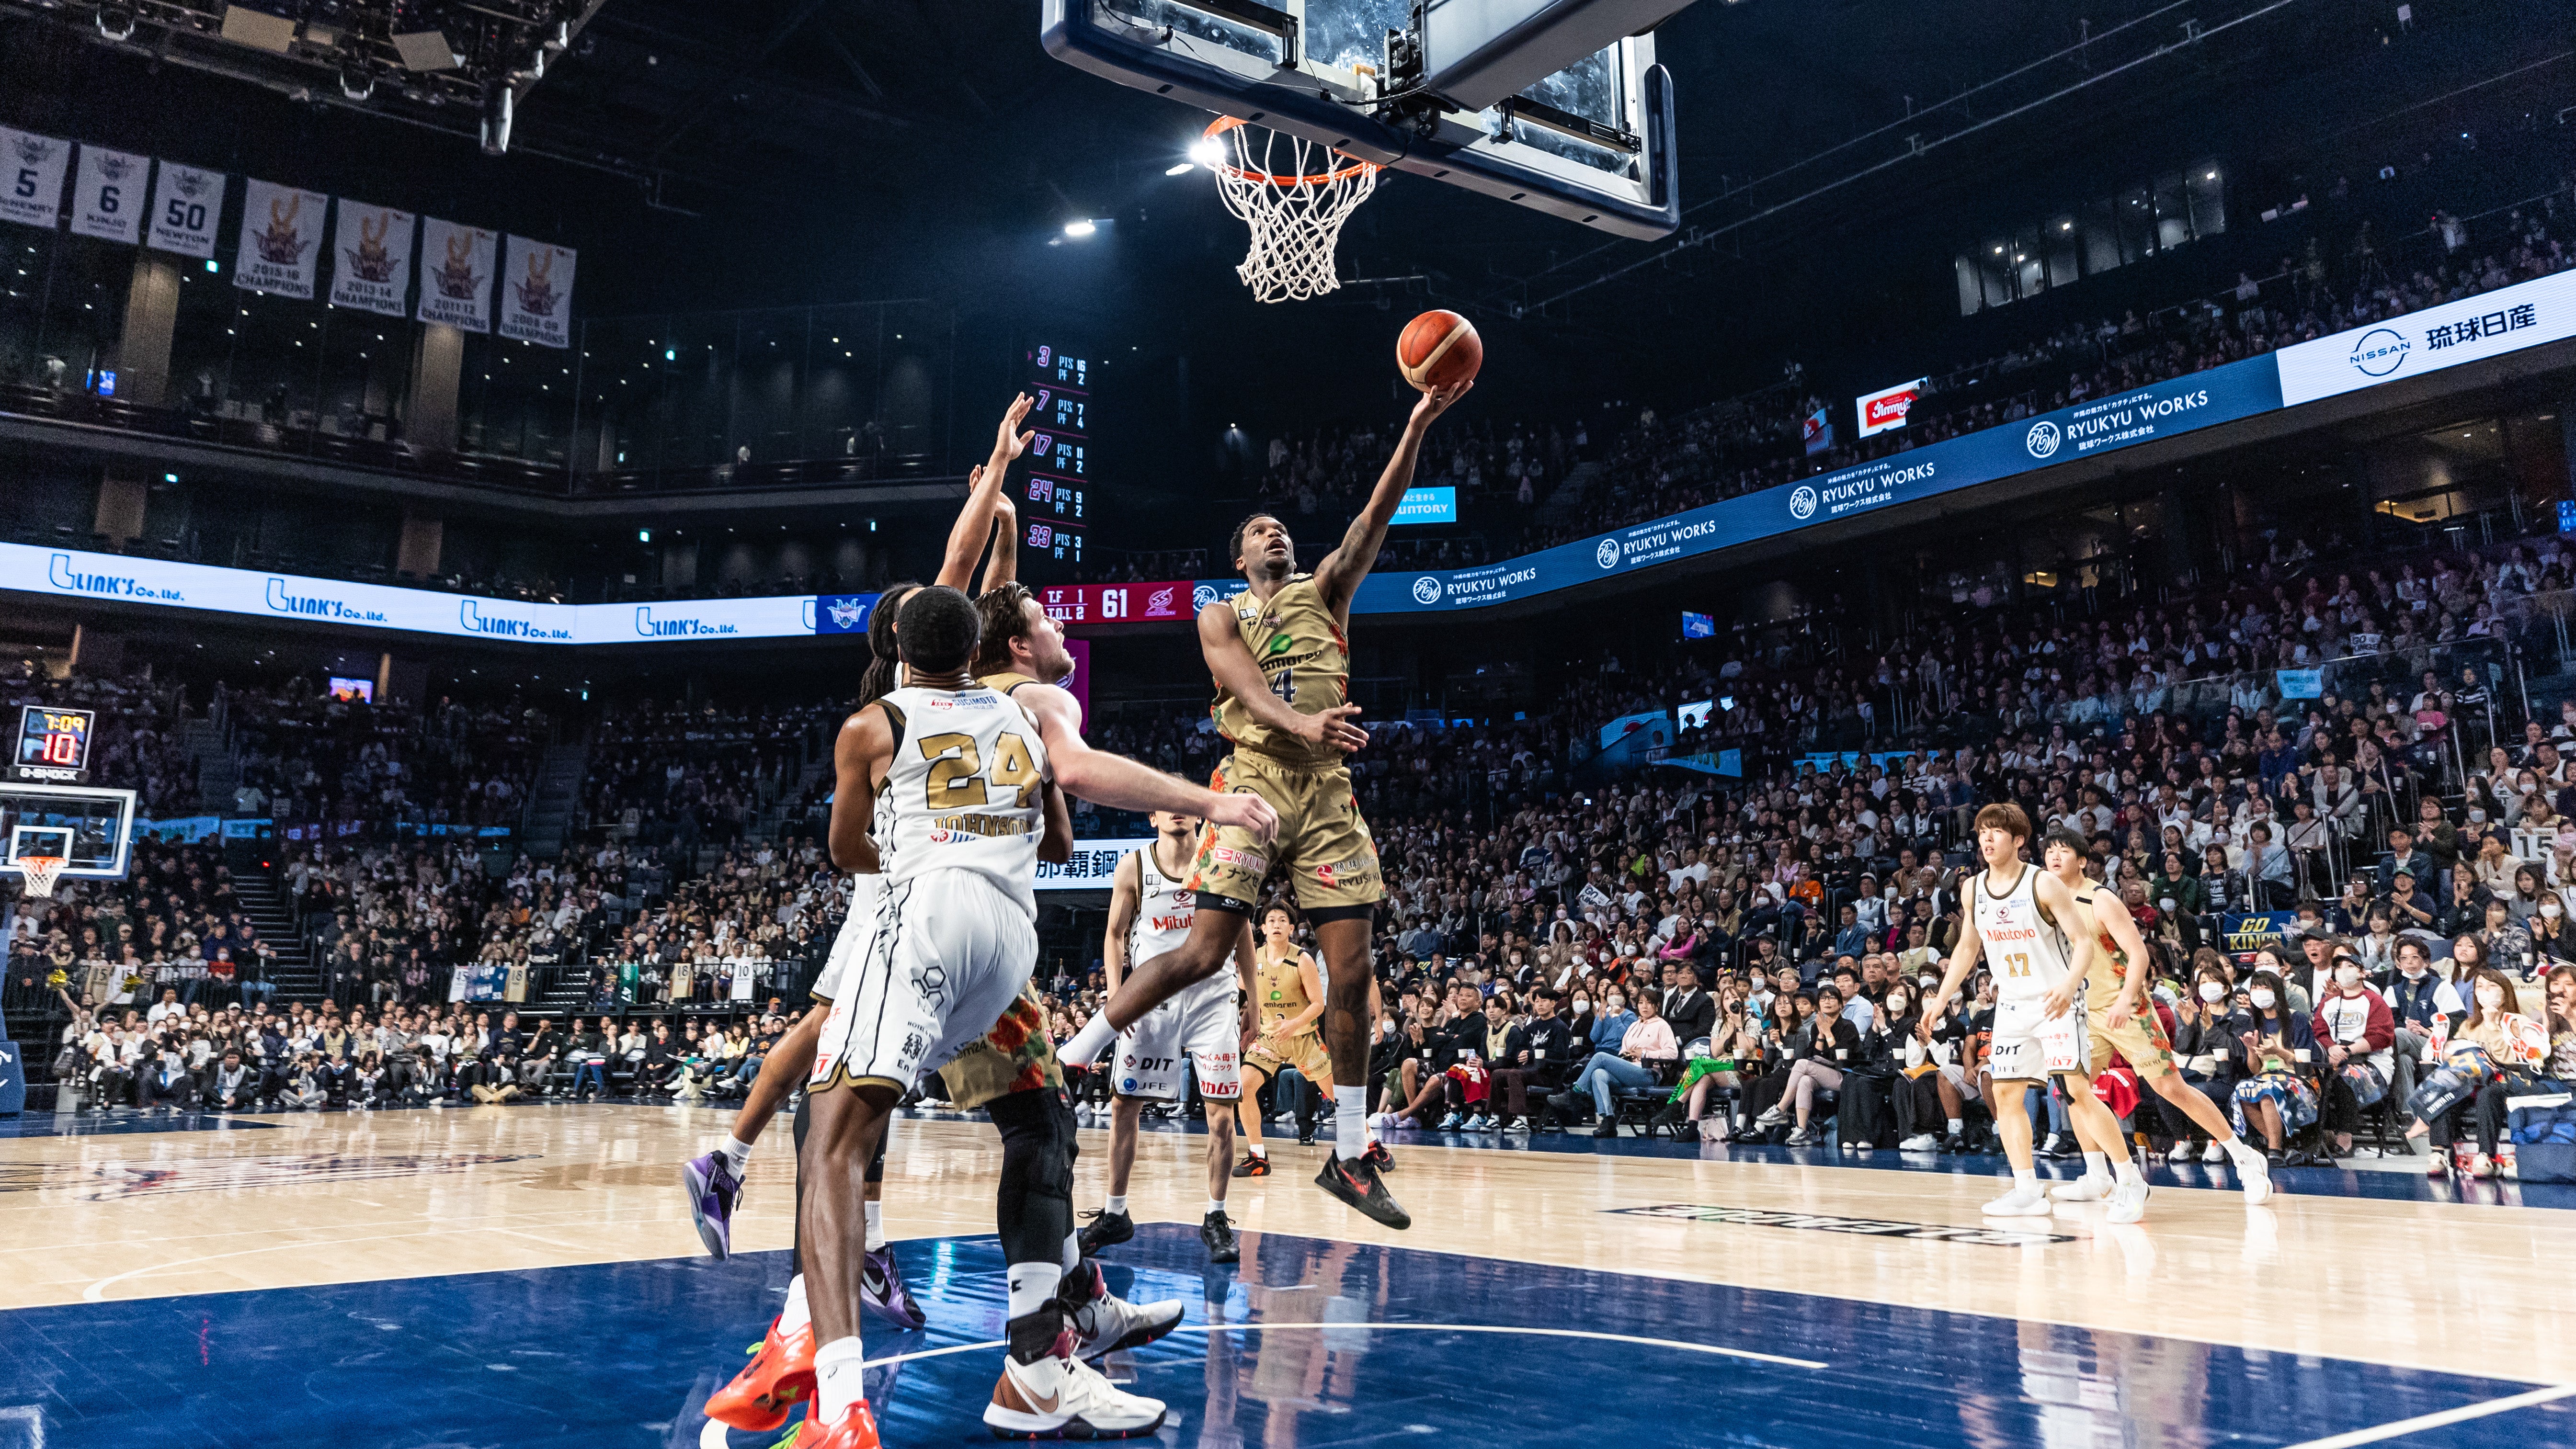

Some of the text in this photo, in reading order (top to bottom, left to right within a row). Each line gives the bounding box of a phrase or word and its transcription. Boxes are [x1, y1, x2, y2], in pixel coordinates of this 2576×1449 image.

[16, 169, 38, 197] 5
[100, 185, 120, 213] 6
[167, 198, 206, 231] 50
[156, 227, 209, 244] NEWTON
[237, 273, 310, 294] CHAMPIONS
[336, 290, 402, 311] CHAMPIONS
[422, 306, 486, 328] CHAMPIONS
[2426, 303, 2537, 351] 琉球日産
[502, 323, 565, 345] CHAMPIONS
[1037, 345, 1050, 367] 3
[2350, 341, 2411, 364] NISSAN
[1059, 355, 1085, 372] PTS 16
[1059, 369, 1084, 385] PF 2
[1036, 390, 1050, 411] 7
[1058, 399, 1083, 416] PTS 7
[1058, 412, 1083, 429] PF 4
[2067, 390, 2208, 440] RYUKYU WORKS
[1033, 434, 1051, 456] 17
[2078, 424, 2154, 451] 琉球ワークス株式会社
[1057, 443, 1083, 459] PTS 11
[1057, 457, 1083, 473] PF 2
[1029, 479, 1053, 502] 24
[1823, 462, 1935, 504] RYUKYU WORKS
[1056, 487, 1082, 503] PTS 9
[1831, 492, 1892, 514] 琉球ワークス株式会社
[1056, 501, 1082, 517] PF 2
[1395, 504, 1448, 515] UNTORY
[1028, 524, 1051, 548] 33
[1055, 533, 1081, 548] PTS 3
[1624, 520, 1715, 555] RYUKYU WORKS
[1055, 547, 1080, 562] PF 1
[1630, 546, 1680, 564] 琉球ワークス株式会社
[77, 573, 134, 595] LINK'S
[1448, 567, 1536, 595] RYUKYU WORKS
[291, 596, 343, 616] LINK'S
[1047, 589, 1083, 604] T.F 1
[1103, 589, 1128, 618] 61
[1456, 590, 1506, 604] 琉球ワークス株式会社
[1076, 606, 1084, 620] 2
[483, 617, 530, 636] LINK'S
[655, 619, 699, 635] LINK'S
[1260, 649, 1322, 671] enhoren
[44, 714, 85, 733] 7:09
[43, 734, 76, 763] 10
[20, 768, 77, 781] G-SHOCK
[917, 731, 1042, 810] 24
[2518, 836, 2553, 858] 15
[1035, 849, 1129, 879] 那覇鋼
[1986, 928, 2036, 942] Mitutoyo
[2239, 917, 2270, 933] GO
[739, 965, 750, 977] 10
[2005, 953, 2031, 977] 17
[1995, 1044, 2021, 1055] DIT
[1140, 1057, 1174, 1072] DIT
[1999, 1065, 2020, 1073] JFE
[1138, 1081, 1167, 1091] JFE
